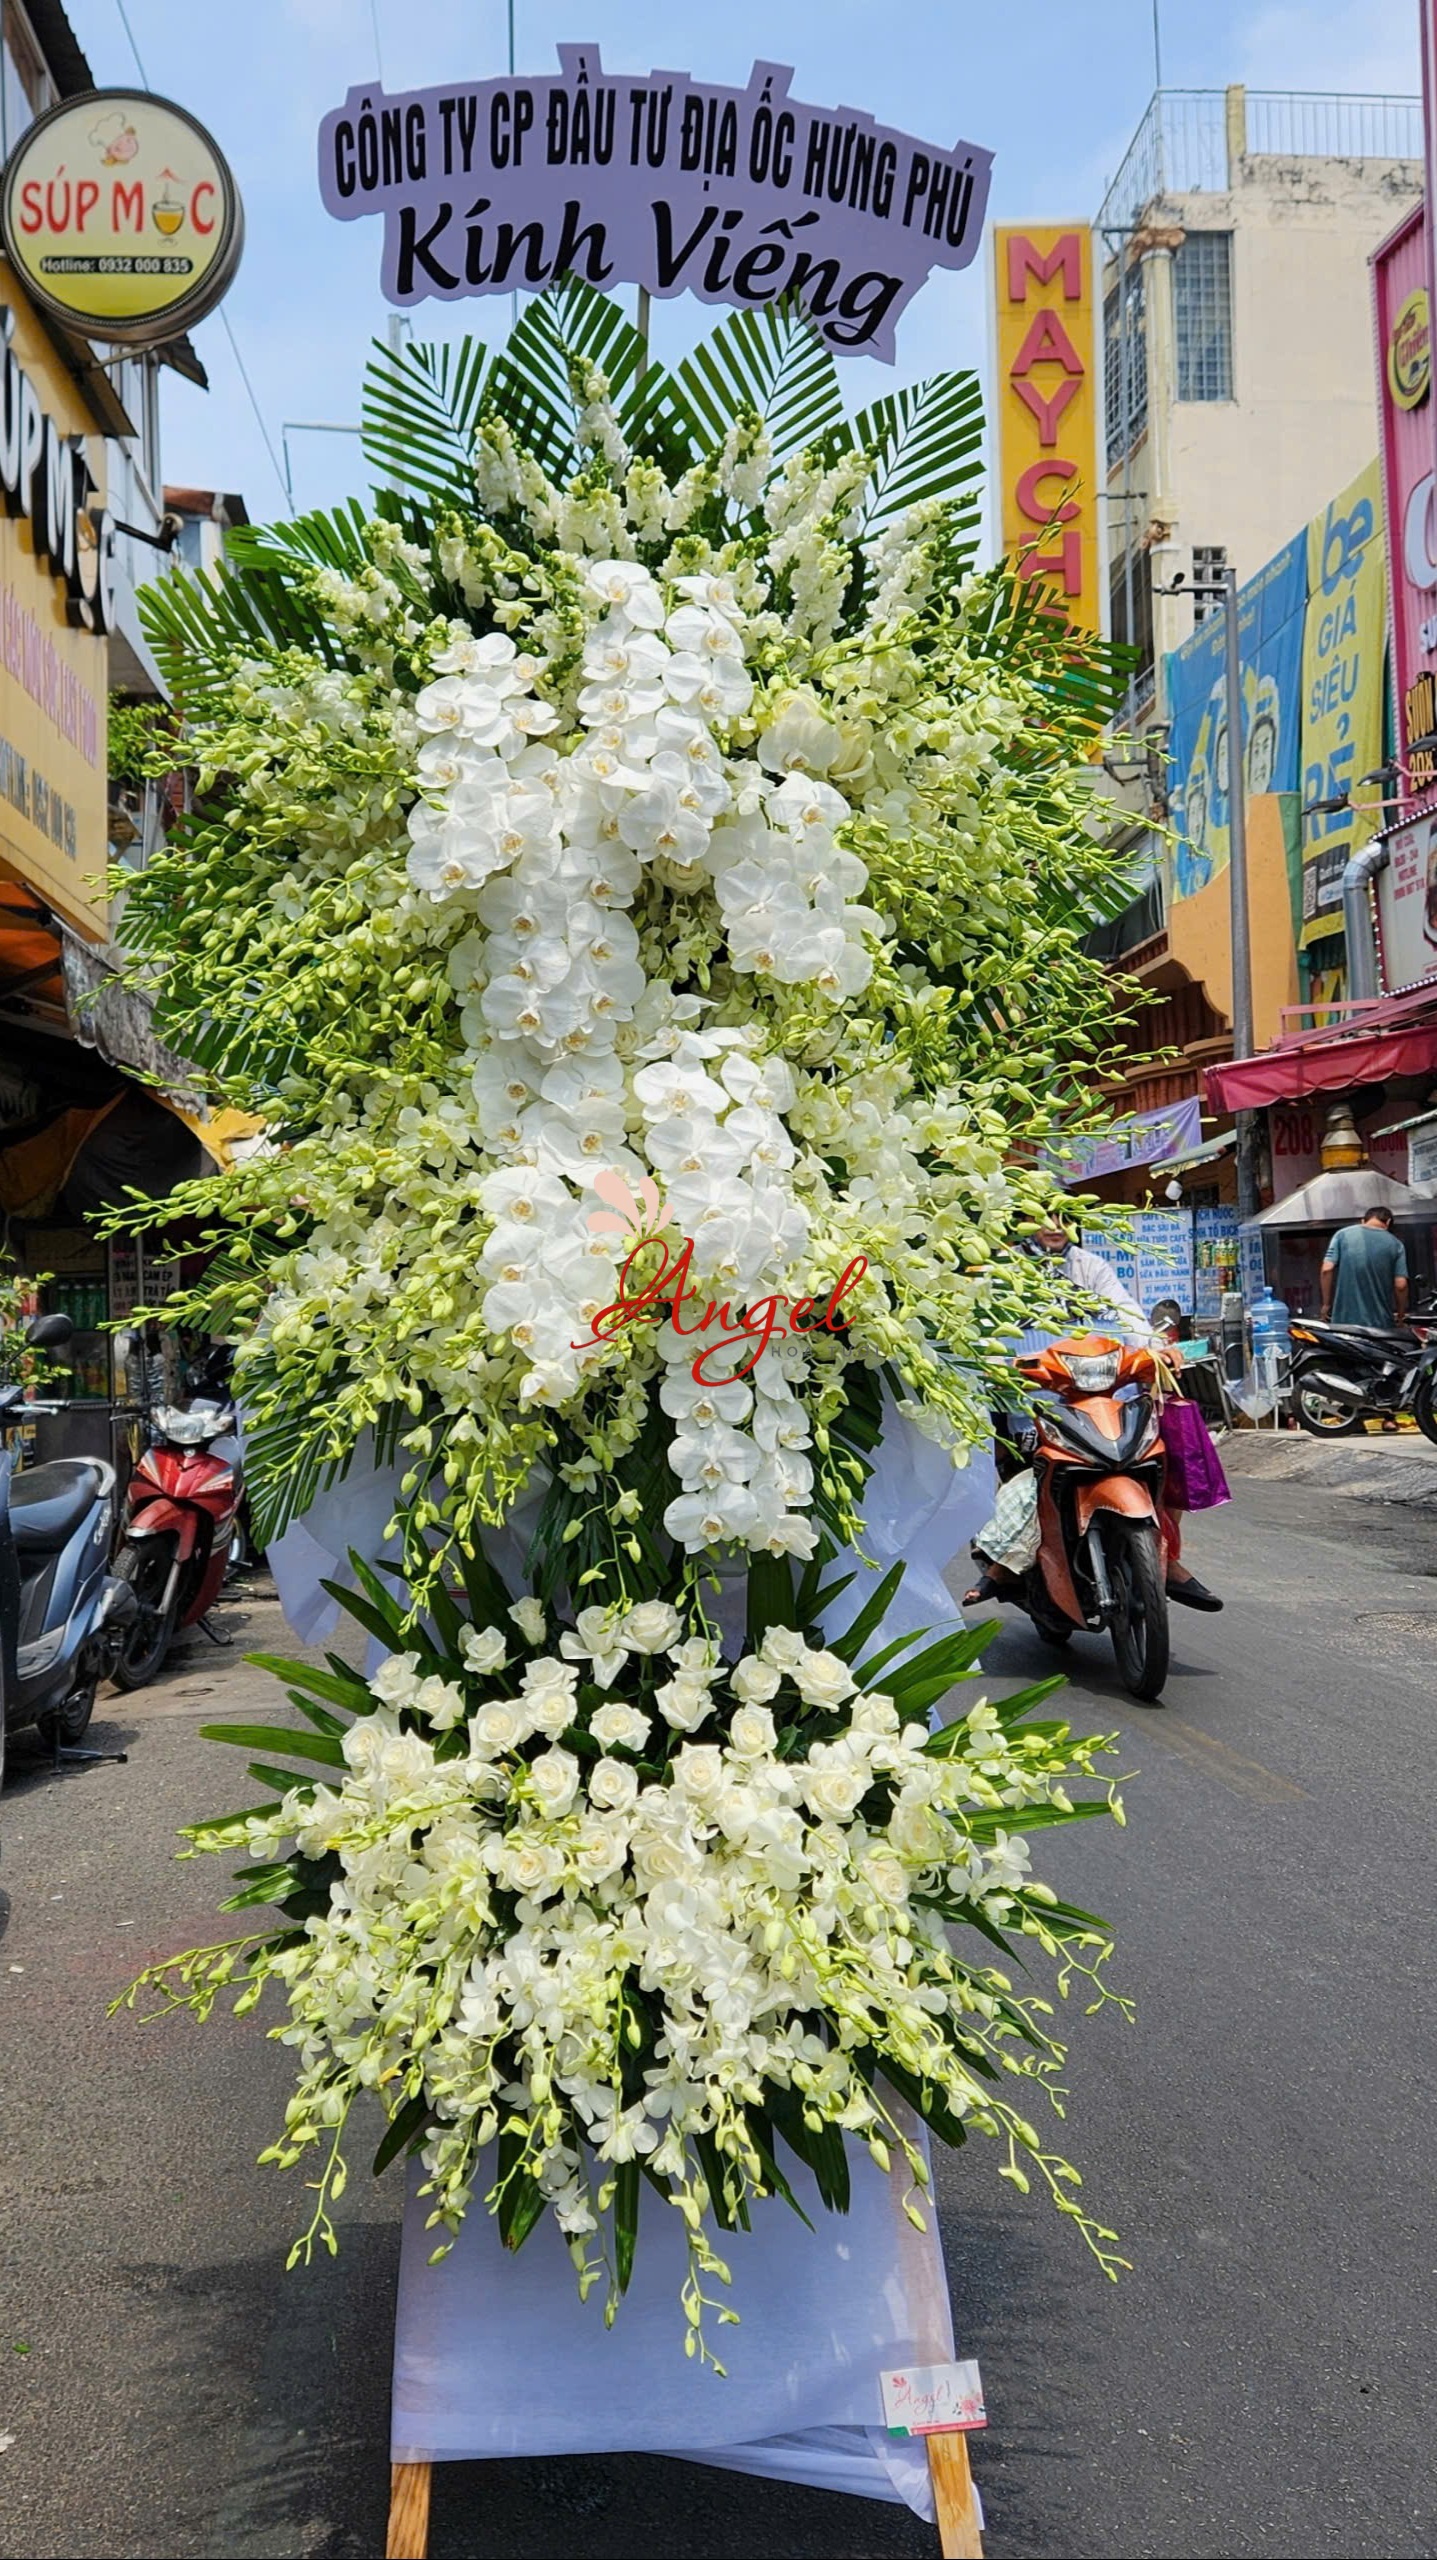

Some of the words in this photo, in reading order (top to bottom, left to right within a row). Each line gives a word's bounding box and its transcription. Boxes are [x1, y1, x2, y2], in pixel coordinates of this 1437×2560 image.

[334, 97, 427, 198] CÔNG
[439, 95, 477, 176] TY
[490, 90, 534, 170] CP
[546, 57, 616, 166] ĐẦU
[630, 85, 673, 168] TƯ
[680, 94, 738, 191] ĐỊA
[749, 76, 795, 189] ỐC
[803, 119, 897, 220] HƯNG
[902, 151, 975, 248] PHÚ
[20, 165, 100, 234] SÚP
[42, 259, 96, 273] Hotline:
[98, 259, 132, 272] 0932
[134, 259, 161, 272] 000
[163, 259, 190, 272] 835
[397, 198, 614, 295] Kính
[651, 200, 904, 347] Viếng
[1321, 498, 1374, 597] be
[1318, 579, 1357, 658] GIÁ
[1310, 653, 1359, 726] SIÊU
[1274, 1113, 1314, 1156] 208
